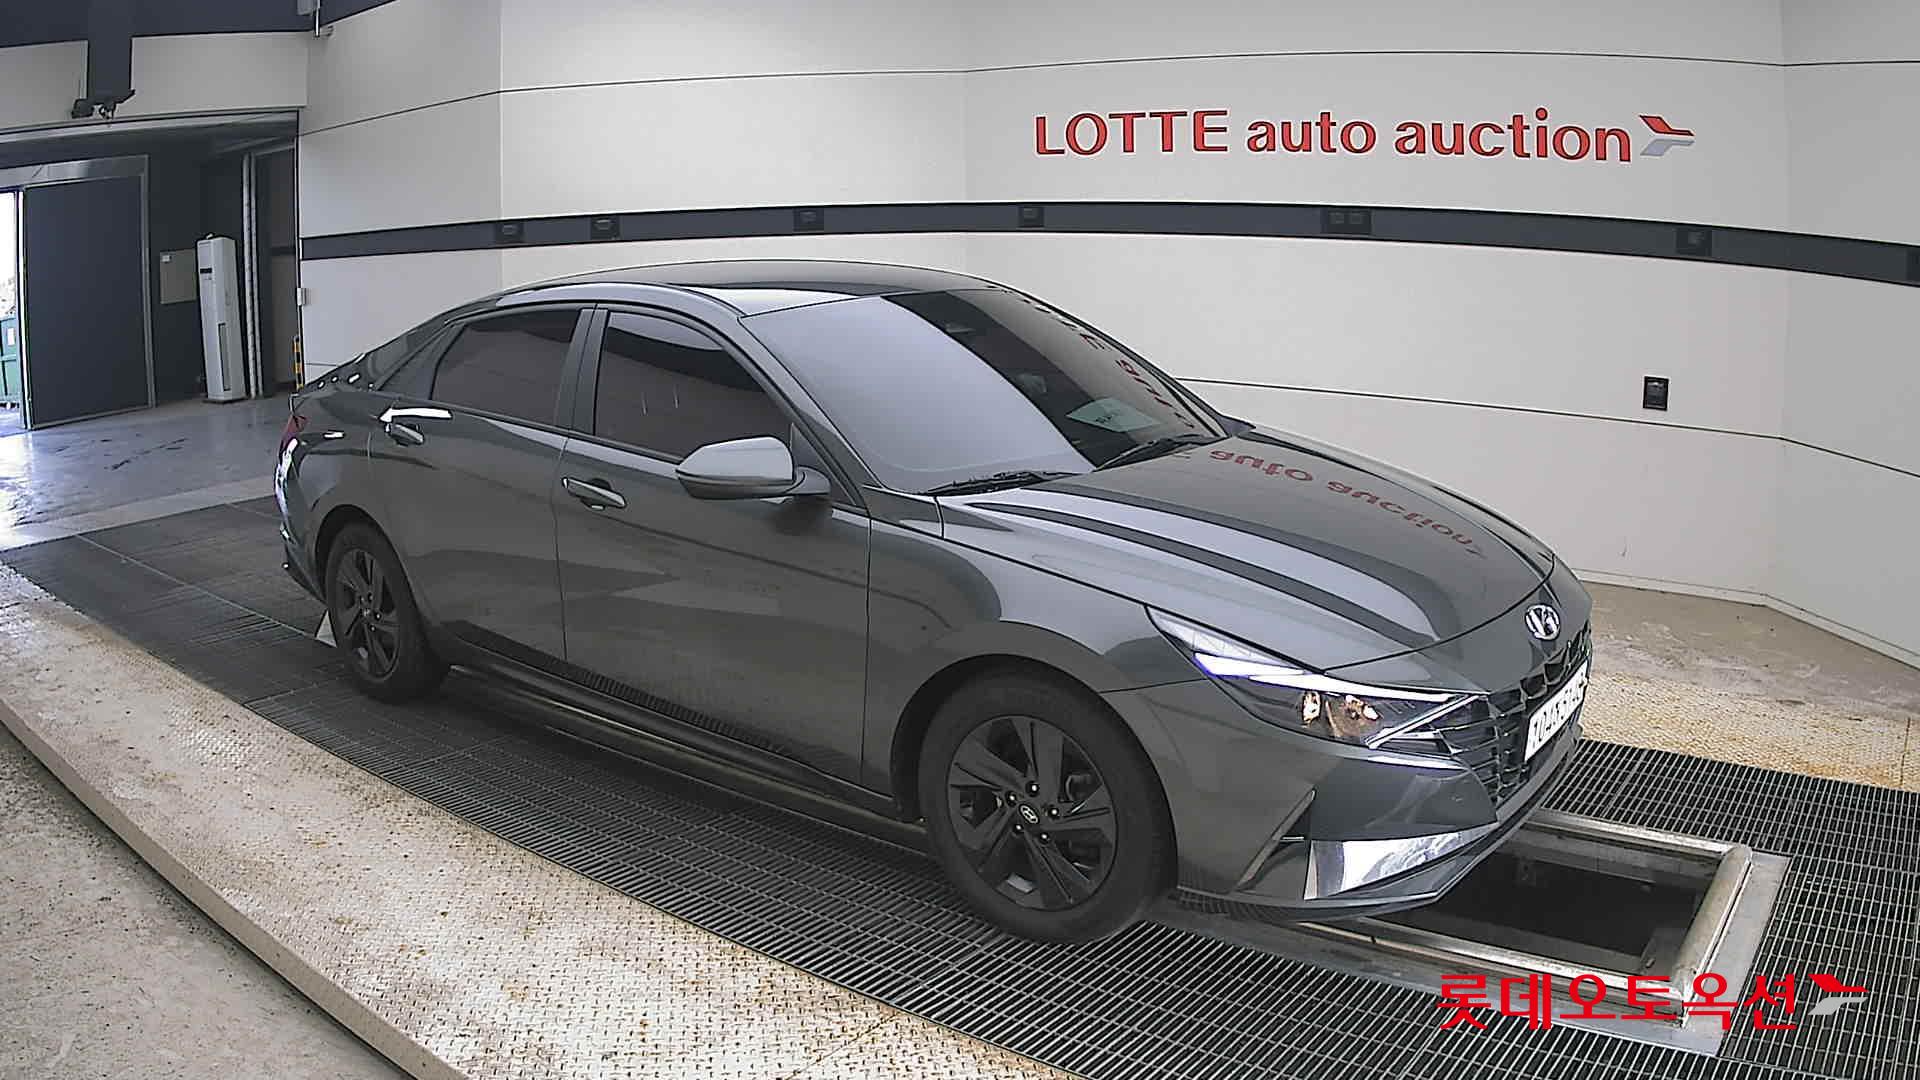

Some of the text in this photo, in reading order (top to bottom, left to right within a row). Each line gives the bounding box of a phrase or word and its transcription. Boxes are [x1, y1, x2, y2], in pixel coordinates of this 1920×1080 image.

[1034, 107, 1632, 162] LOTTE auto auction
